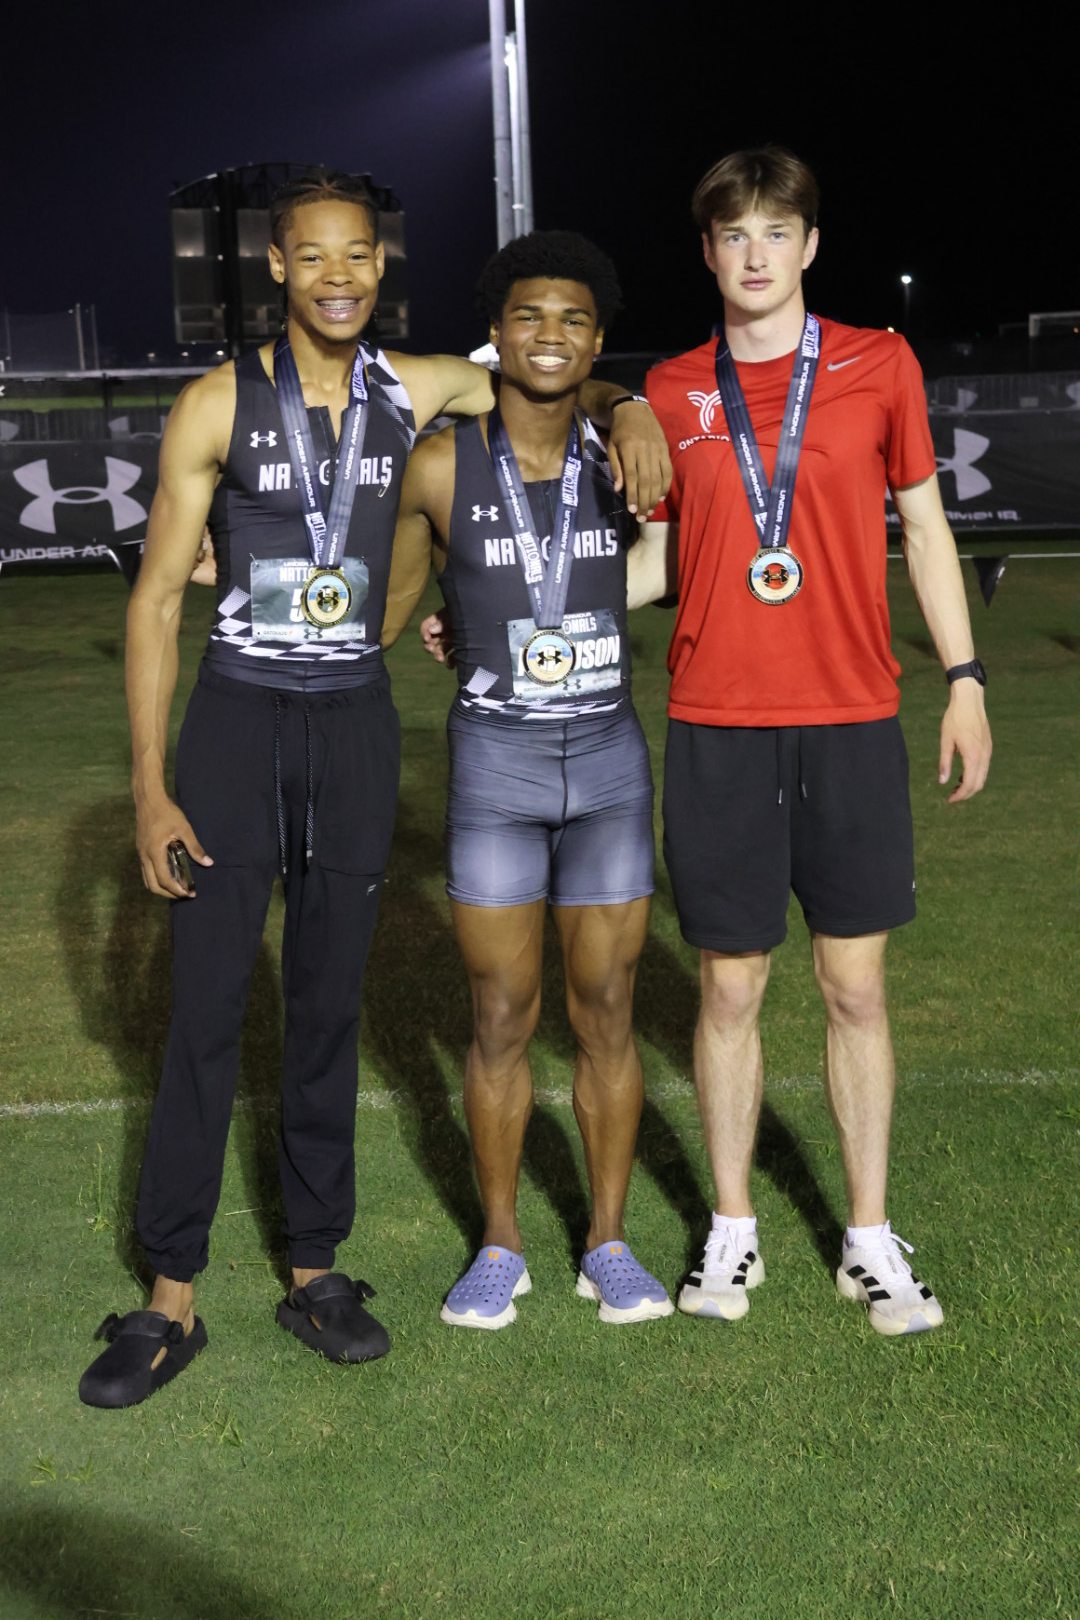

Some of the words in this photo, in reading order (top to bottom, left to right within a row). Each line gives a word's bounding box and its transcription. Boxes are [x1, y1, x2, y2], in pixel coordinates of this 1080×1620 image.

[790, 404, 802, 437] UNDER
[797, 361, 810, 402] ARMOUR
[344, 447, 355, 480] UNDER
[351, 404, 362, 445] ARMOUR
[258, 456, 392, 492] NAALS
[295, 430, 306, 463] UNDER
[302, 465, 316, 507] ARMOUR
[740, 433, 753, 465] UNDER
[748, 466, 765, 507] ARMOUR
[500, 456, 513, 487] UNDER
[509, 488, 525, 528] ARMOUR
[776, 489, 786, 523] UNDER
[1, 546, 74, 561] UNDER
[328, 532, 338, 565] UNDER
[484, 528, 618, 567] NANALS
[555, 551, 565, 583] UNDER
[561, 510, 571, 550] ARMOUR
[772, 524, 781, 547] ARM
[562, 617, 597, 635] ONALS
